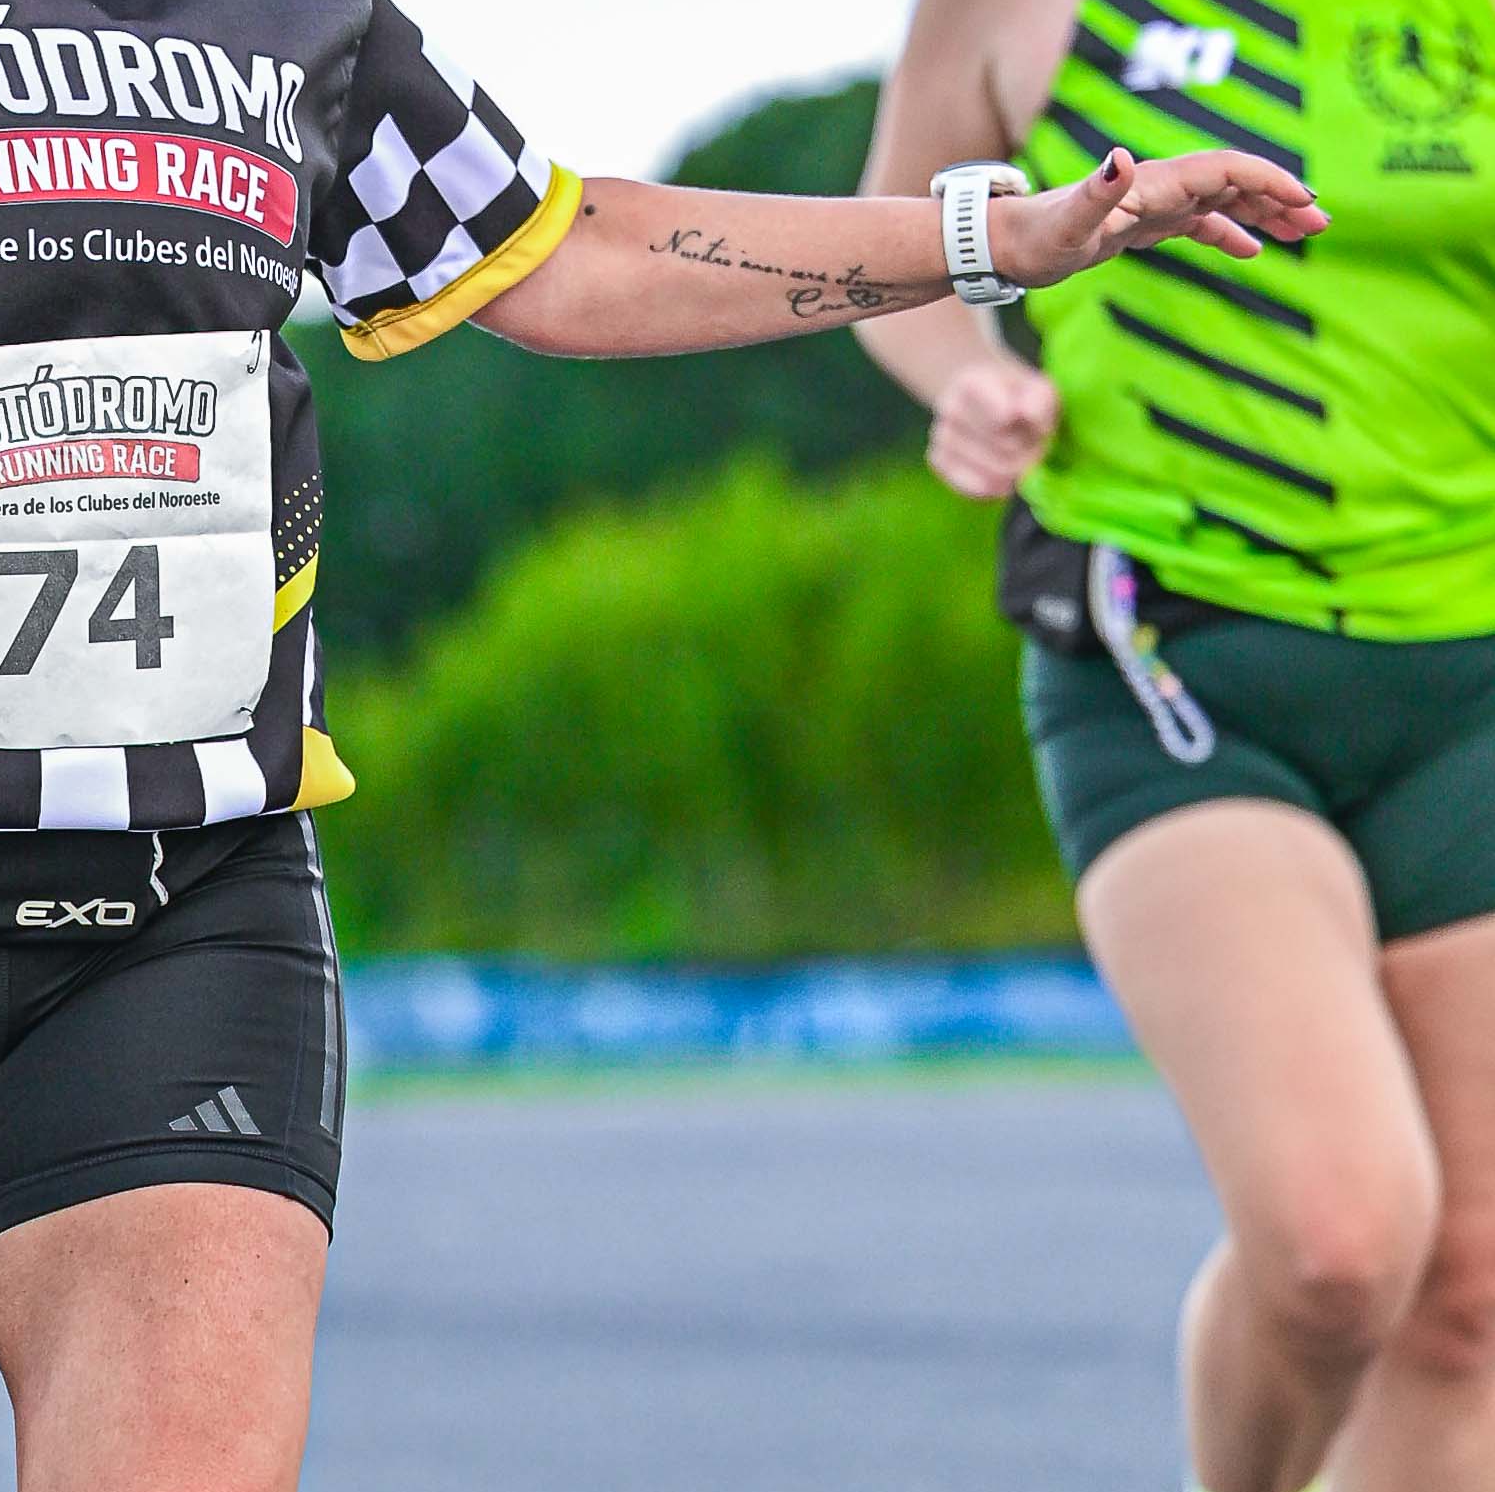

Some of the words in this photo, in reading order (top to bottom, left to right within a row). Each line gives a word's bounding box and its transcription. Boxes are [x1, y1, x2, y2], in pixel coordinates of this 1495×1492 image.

[155, 142, 270, 224] RACE
[27, 228, 75, 261] los
[83, 229, 189, 265] Clubes
[195, 235, 235, 271] del
[112, 442, 177, 477] RACE
[23, 497, 46, 515] de
[50, 496, 74, 513] los
[77, 493, 130, 512] Clubes
[132, 492, 155, 509] del
[159, 491, 221, 508] Noroeste
[15, 898, 136, 928] EXO
